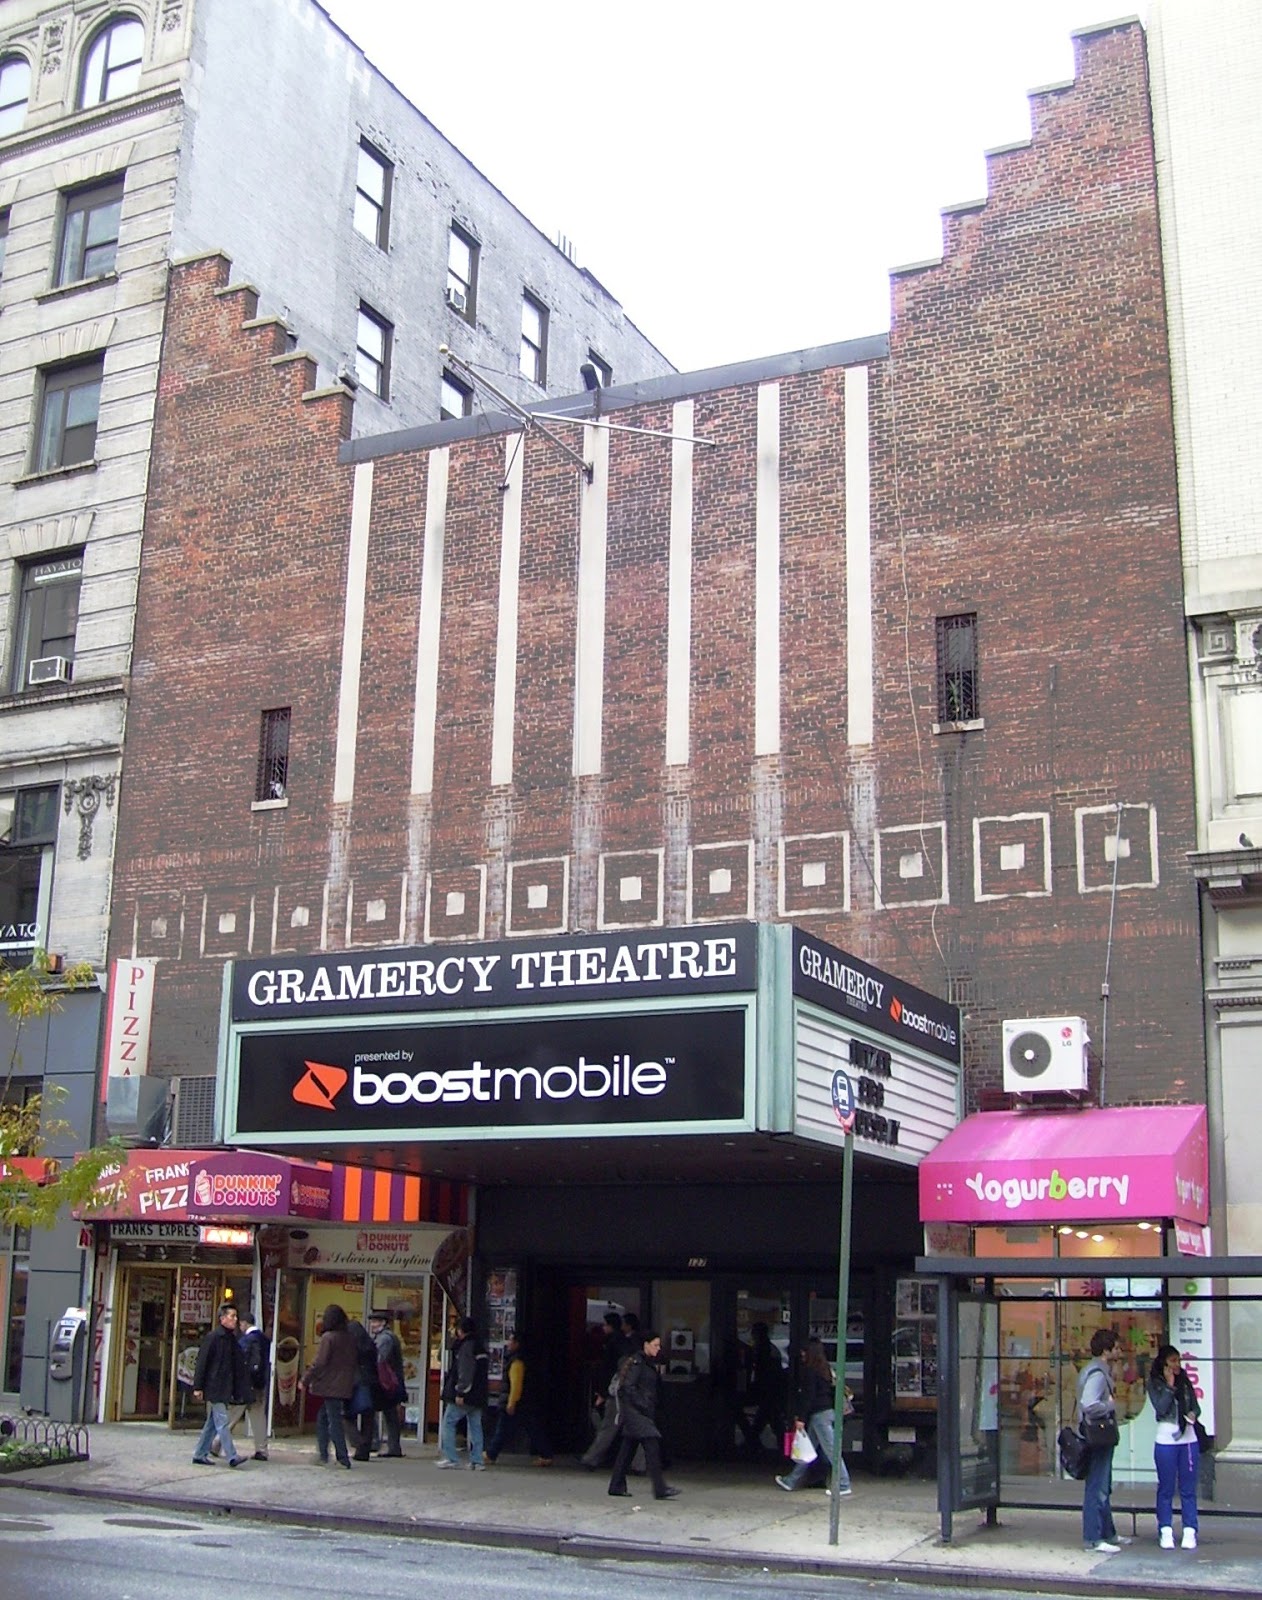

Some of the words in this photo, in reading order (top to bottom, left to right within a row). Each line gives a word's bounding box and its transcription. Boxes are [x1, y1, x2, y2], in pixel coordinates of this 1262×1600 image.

[248, 955, 501, 1006] GRAMERCY
[511, 938, 737, 990] THEATRE
[800, 945, 884, 1009] GRAMERCY
[354, 1051, 399, 1064] presented
[402, 1050, 414, 1062] by
[214, 1174, 282, 1191] DUNKIN'
[966, 1169, 1129, 1208] Yogurberry
[213, 1190, 277, 1206] DONUTS
[113, 1224, 153, 1236] FRANKS
[206, 1230, 248, 1244] ATM
[369, 1234, 413, 1242] DUNKIN'
[369, 1243, 410, 1251] DONUTS
